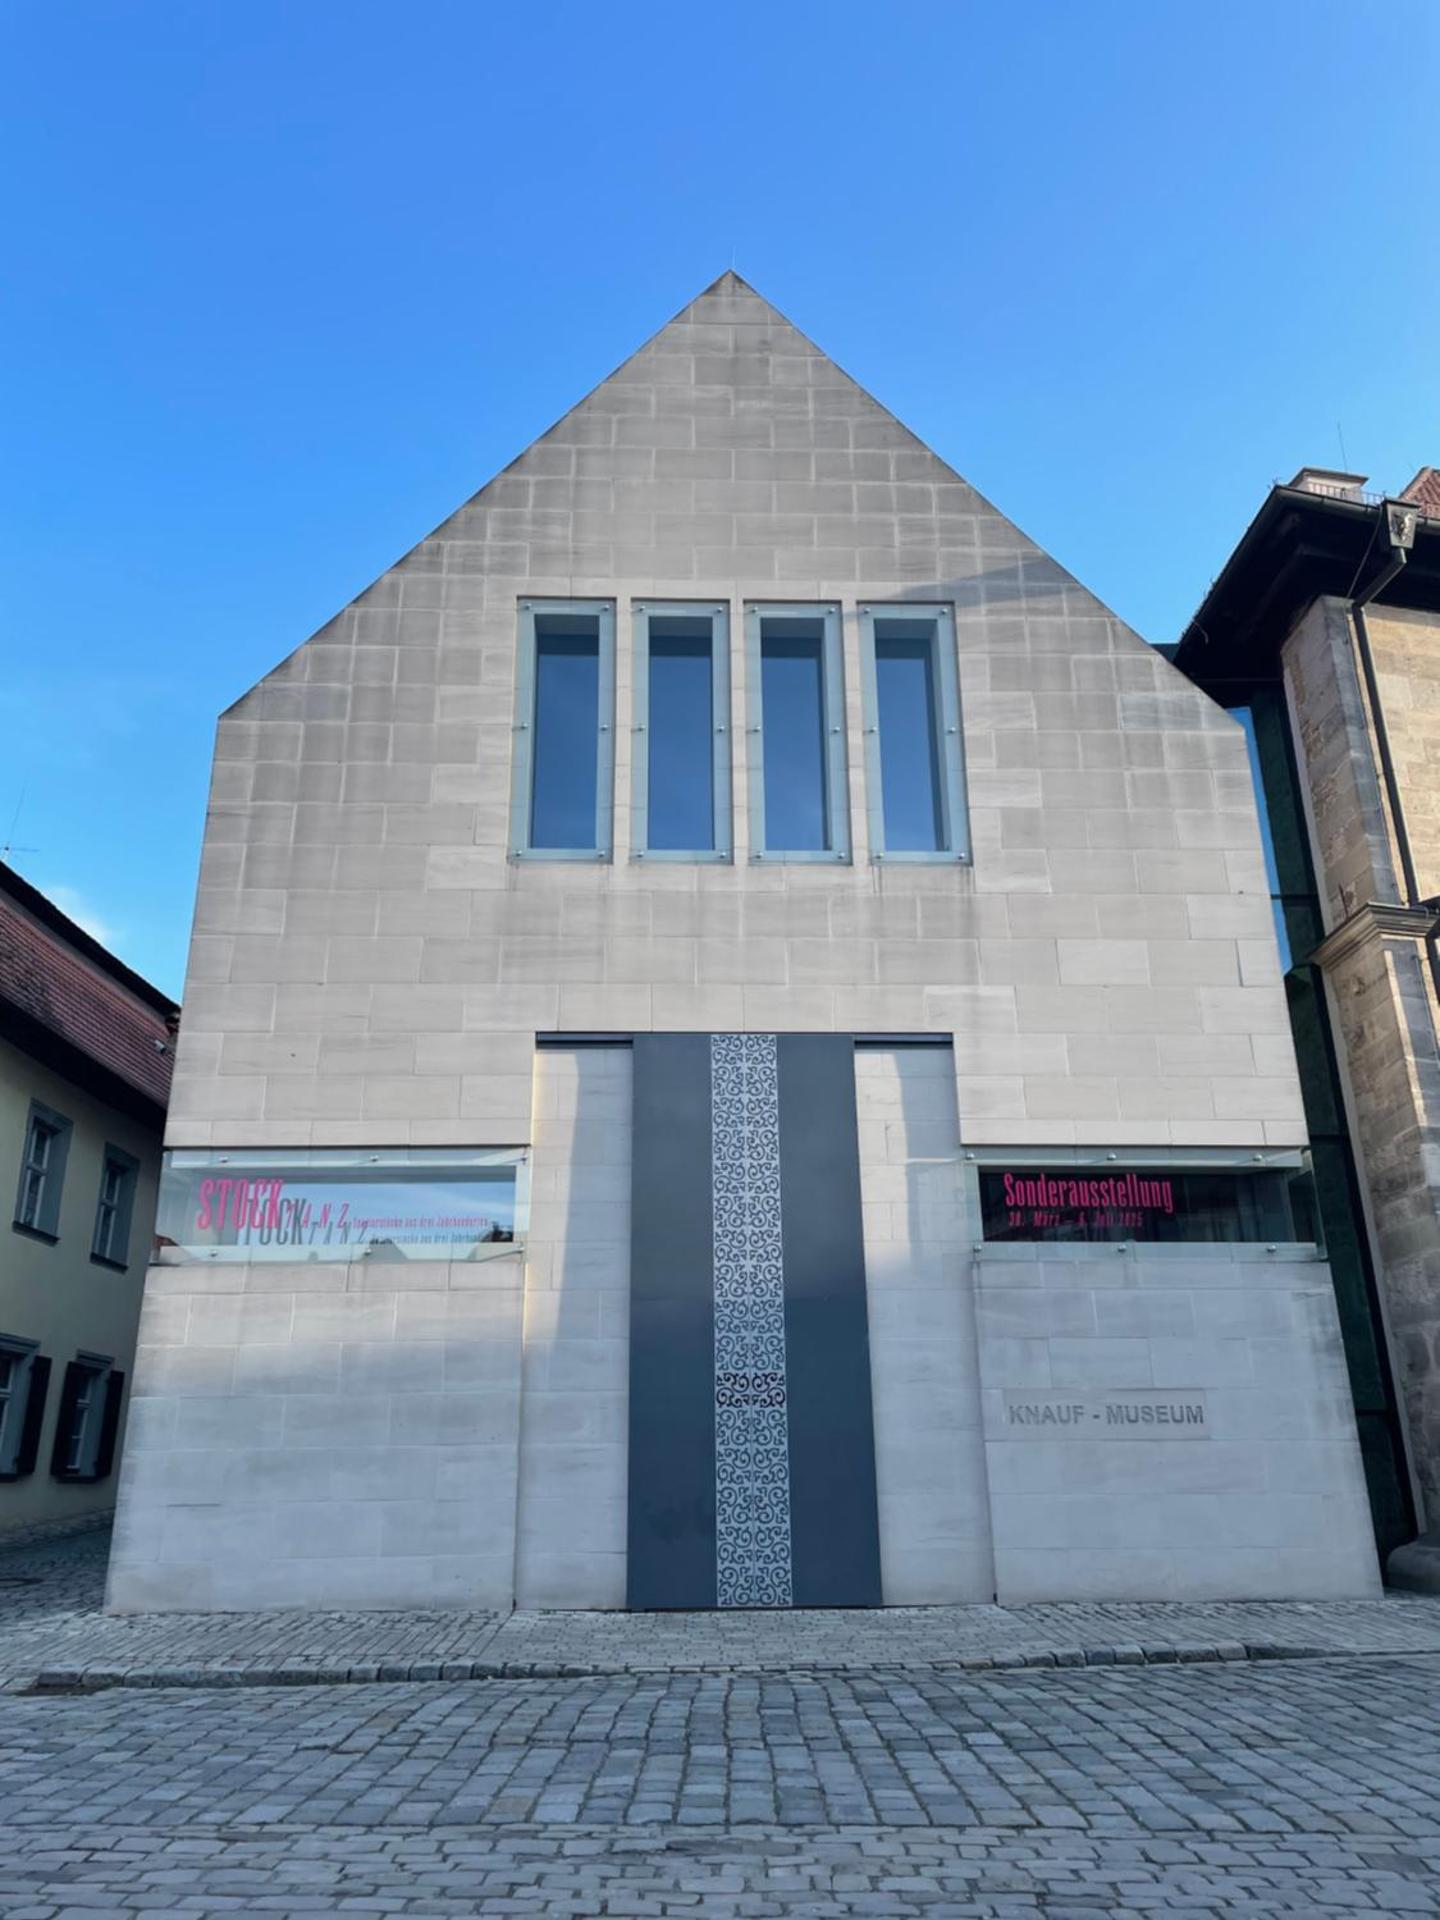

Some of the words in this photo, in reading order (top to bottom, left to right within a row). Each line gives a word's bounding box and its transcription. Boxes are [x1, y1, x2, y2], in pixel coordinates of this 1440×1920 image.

[196, 1177, 283, 1230] STOCK
[1003, 1173, 1173, 1213] Sonderausstellung
[1009, 1405, 1084, 1425] KNAUF
[1105, 1405, 1204, 1424] MUSEUM
